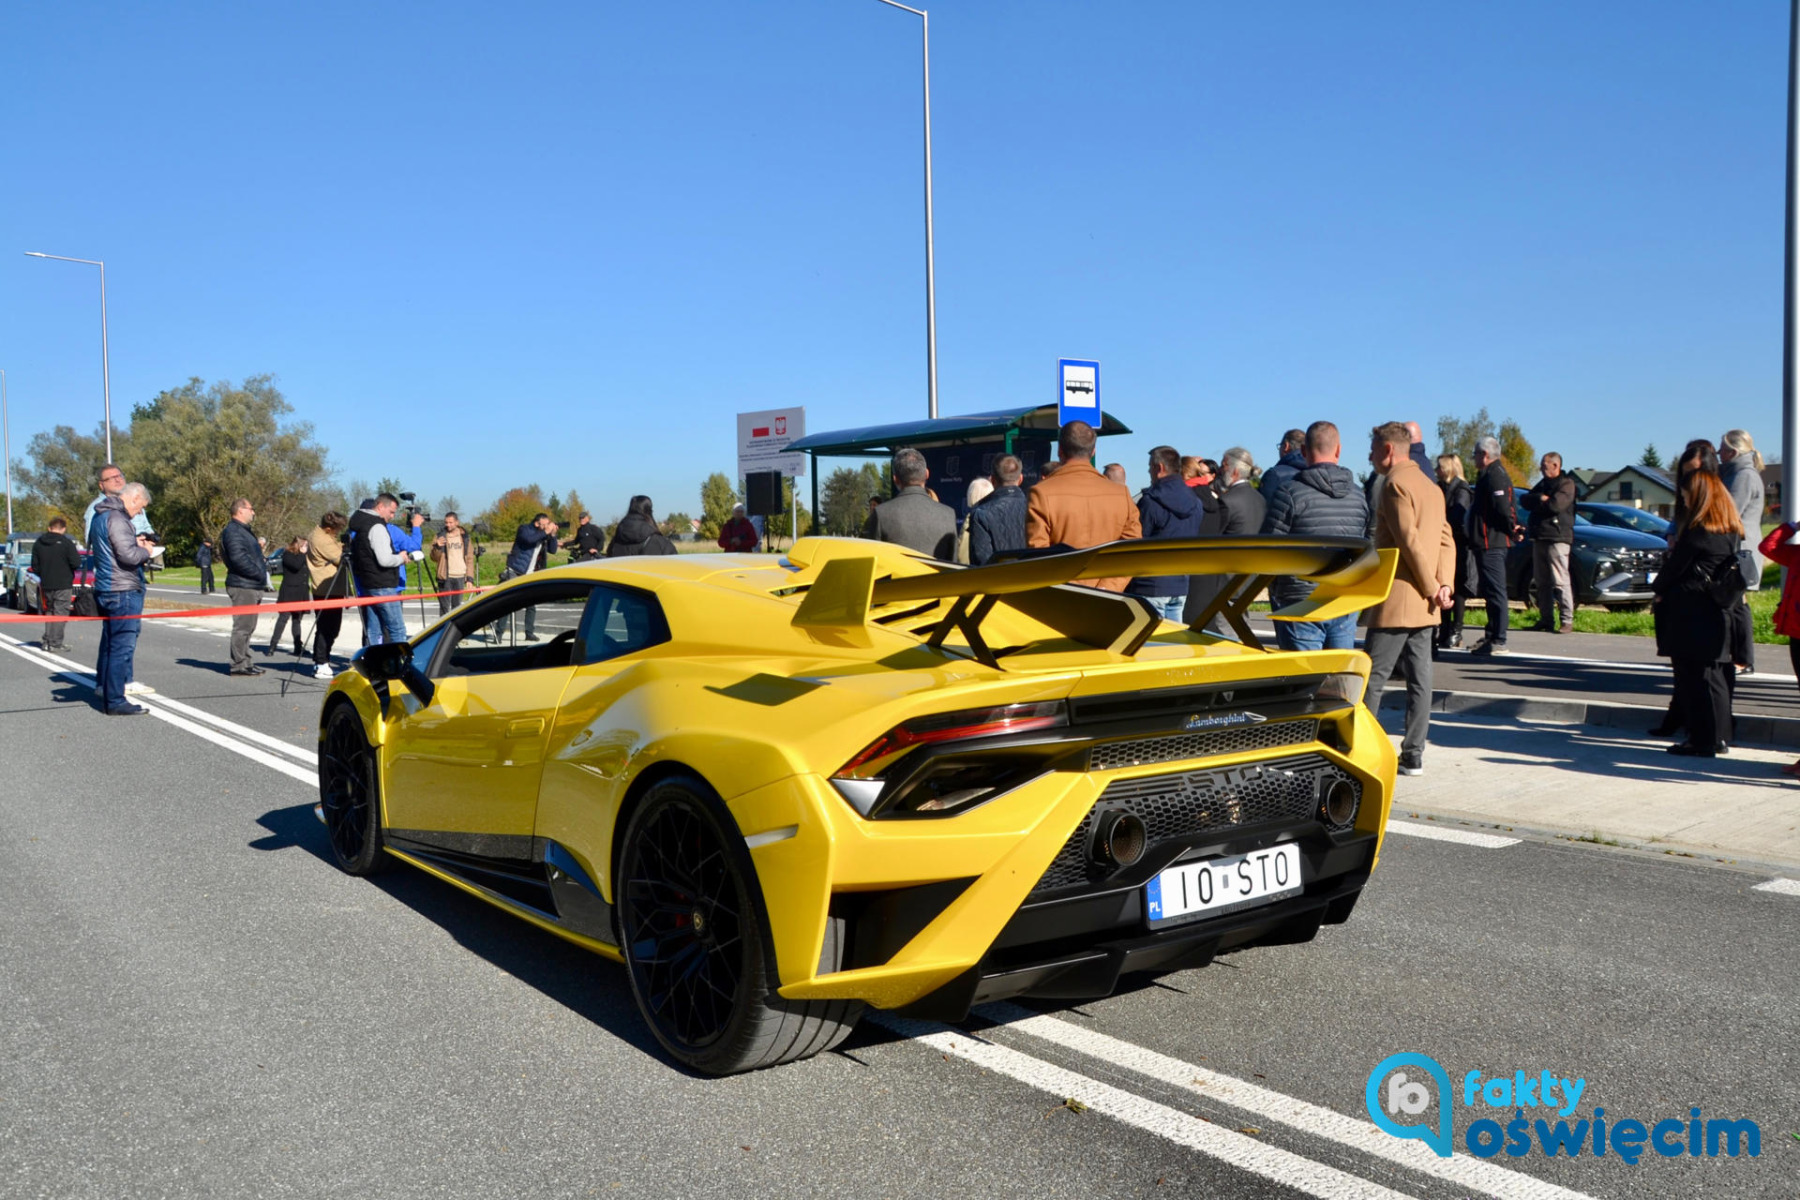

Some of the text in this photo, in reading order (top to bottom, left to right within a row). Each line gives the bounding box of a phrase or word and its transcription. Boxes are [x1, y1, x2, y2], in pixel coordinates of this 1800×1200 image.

[1186, 712, 1246, 729] Lamborghini
[1237, 851, 1288, 896] STO
[1149, 902, 1161, 914] PL
